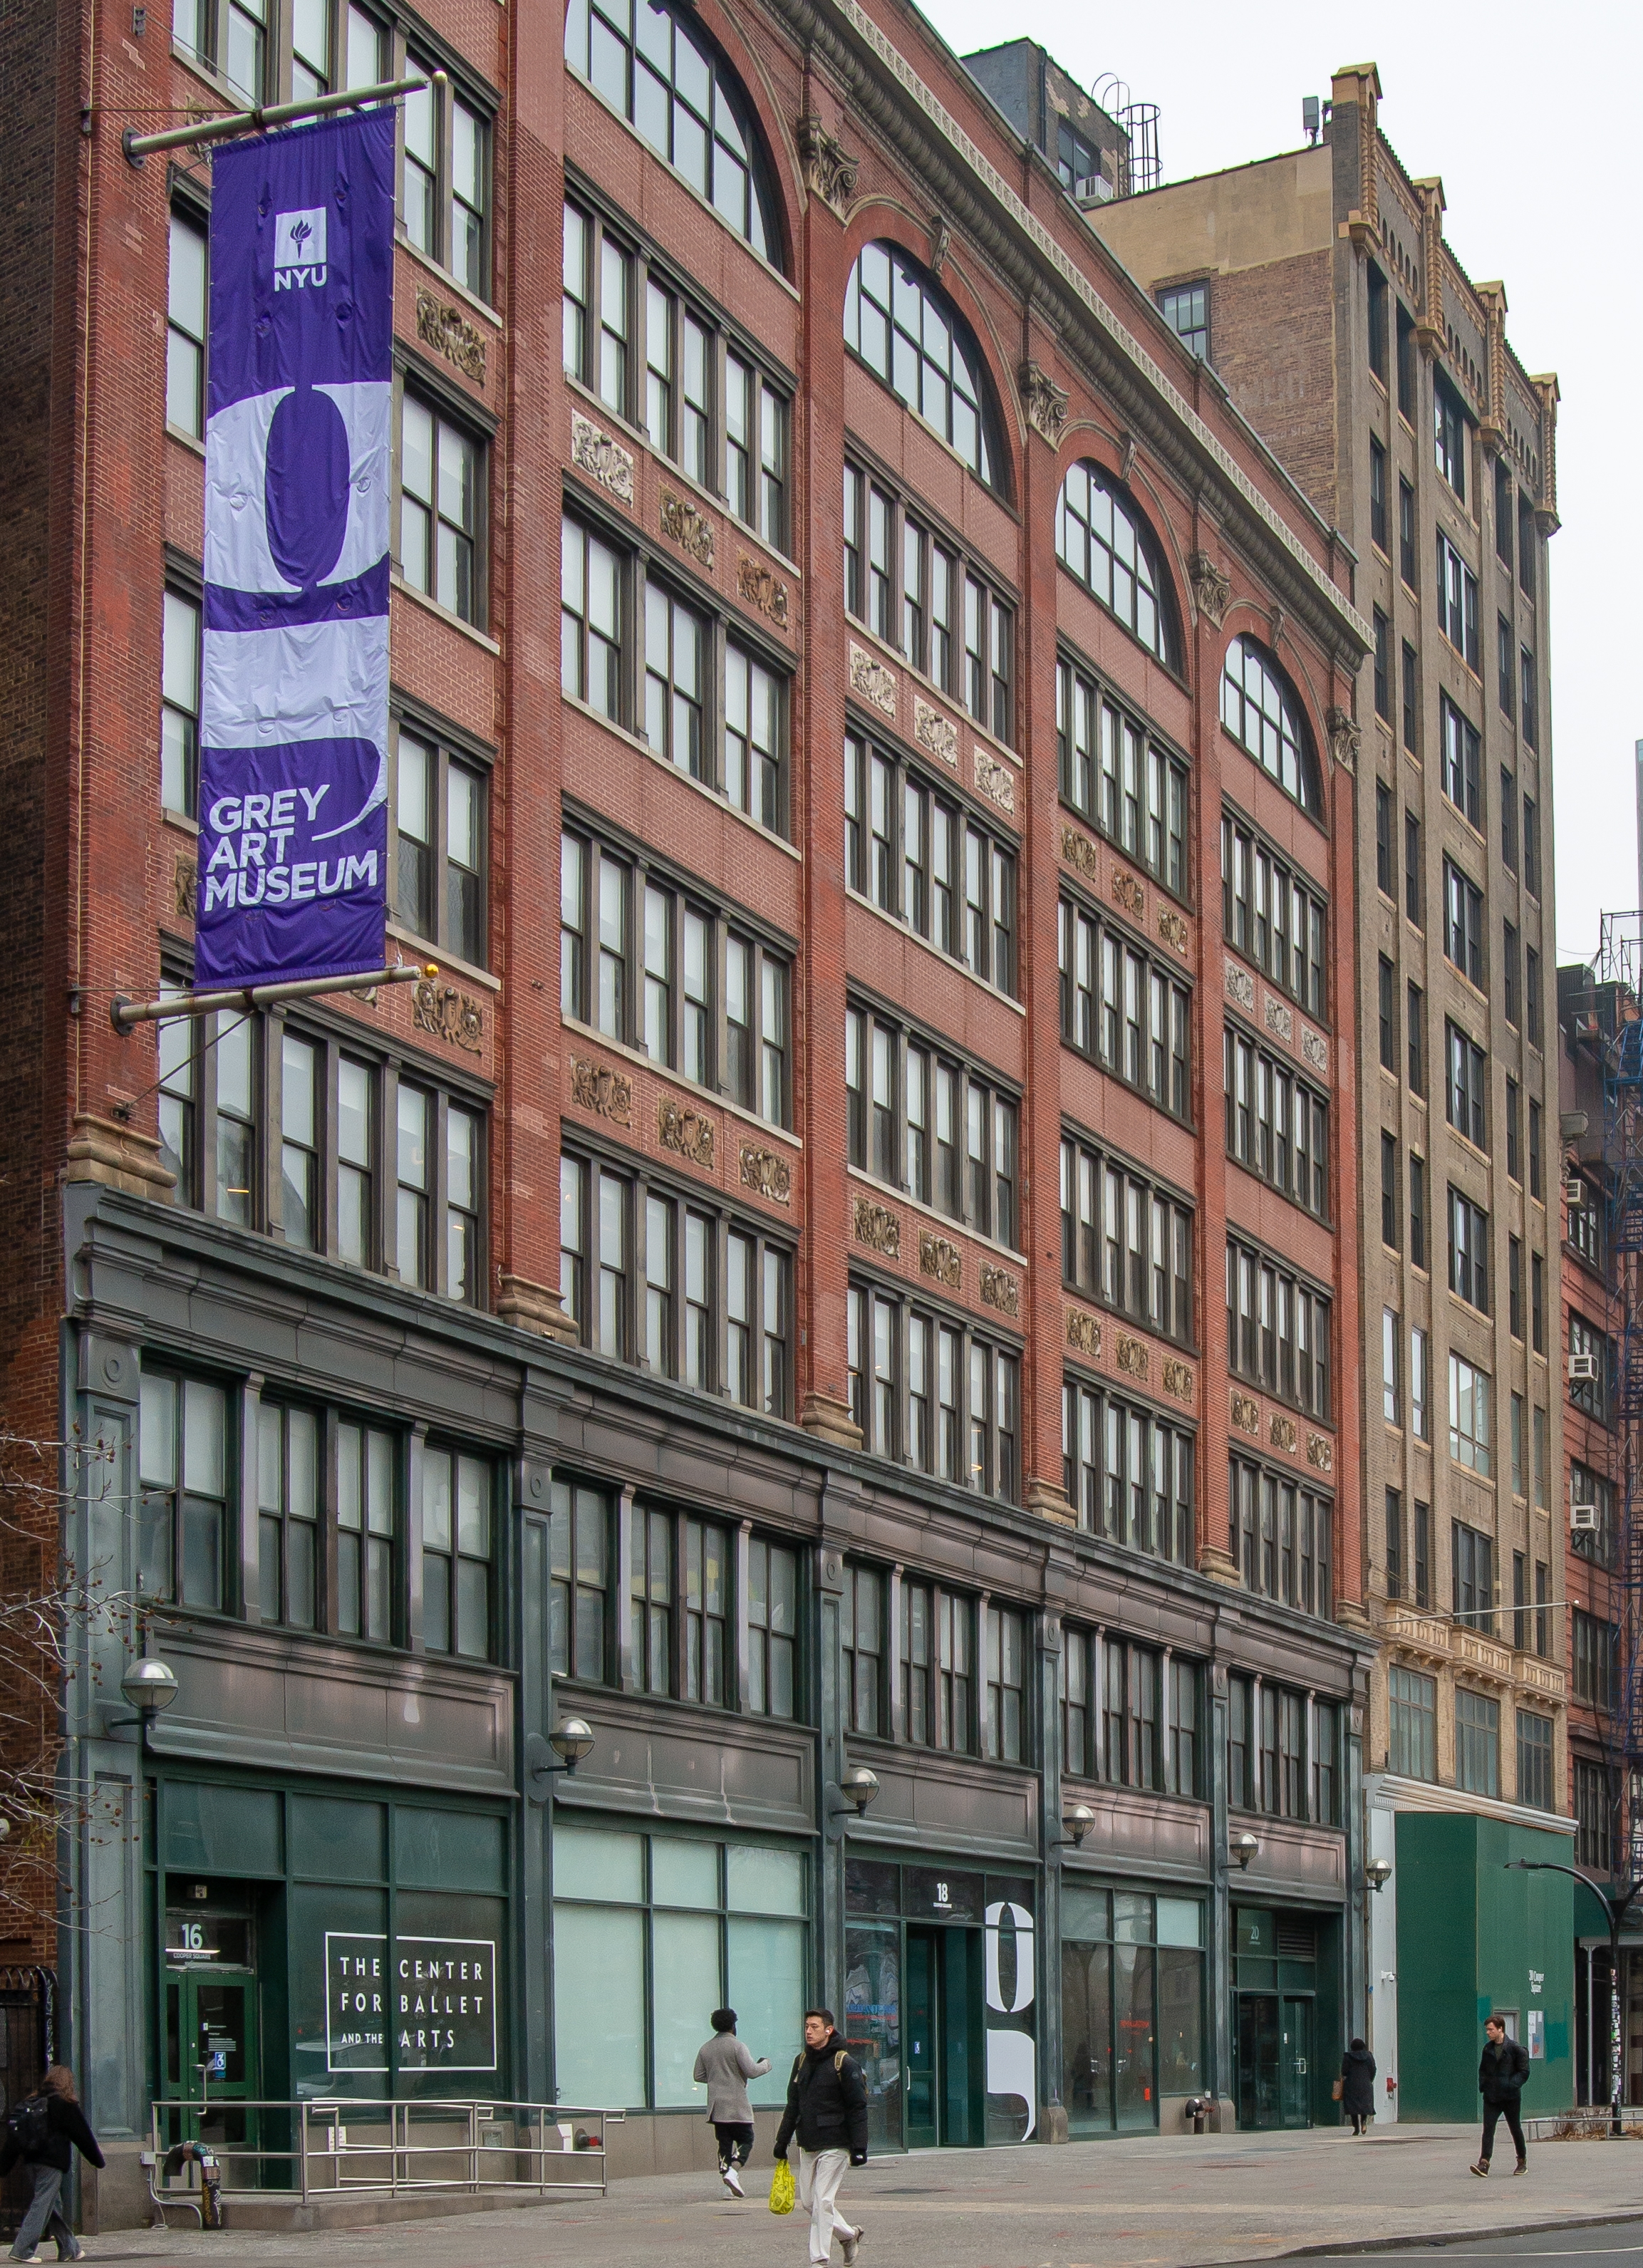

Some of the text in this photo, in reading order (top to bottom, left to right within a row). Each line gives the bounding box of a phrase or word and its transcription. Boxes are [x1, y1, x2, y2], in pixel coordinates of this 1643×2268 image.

[274, 265, 328, 292] NYU
[209, 784, 331, 834] GREY
[205, 827, 295, 873] ART
[204, 849, 378, 912] MUSEUM
[936, 1883, 948, 1902] 18
[181, 1923, 203, 1949] 16
[339, 1957, 483, 1980] THE CENTER
[341, 1992, 483, 2014] FOR BALLET
[341, 2029, 455, 2049] AND THE ARTS
